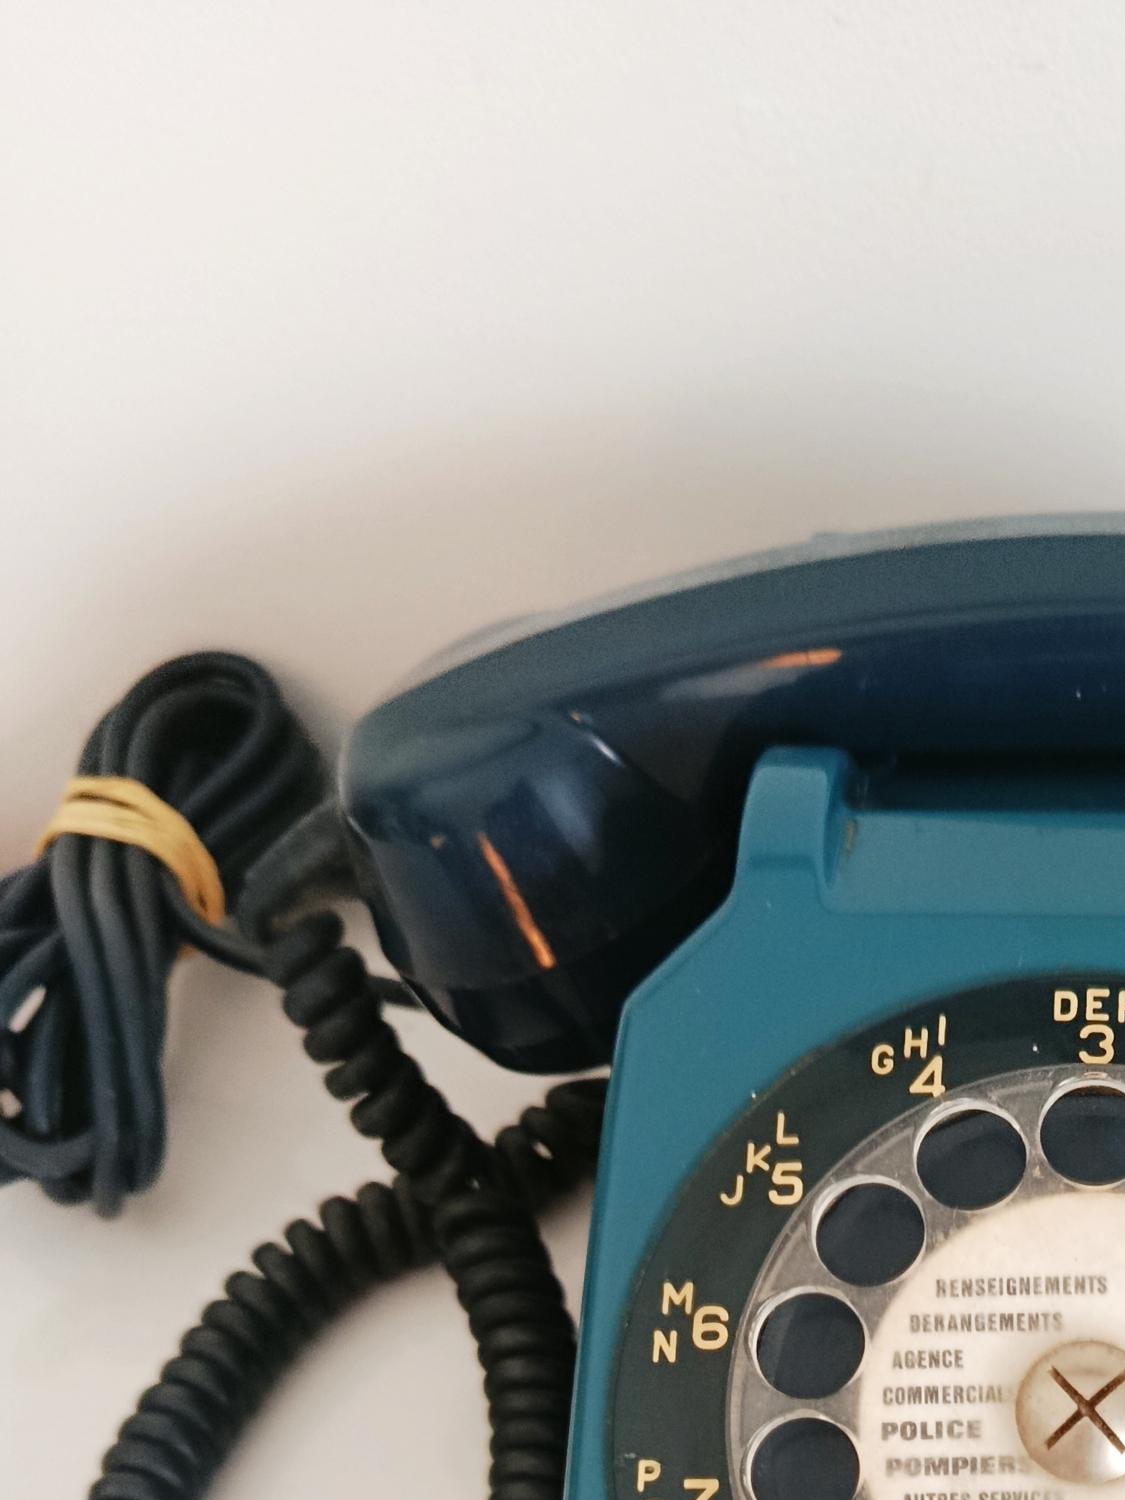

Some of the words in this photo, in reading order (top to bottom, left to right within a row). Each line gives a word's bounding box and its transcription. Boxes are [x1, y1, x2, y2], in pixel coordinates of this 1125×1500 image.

[1078, 1023, 1115, 1065] 3
[908, 1055, 946, 1098] 4
[768, 1161, 804, 1206] 5
[935, 1275, 1108, 1298] RENSEIGNEMENTS
[691, 1305, 730, 1351] 6
[910, 1312, 1064, 1333] DERANGEMENTS
[892, 1350, 964, 1369] AGENCE
[881, 1420, 982, 1441] POLICE
[884, 1455, 1034, 1477] POMPIERS
